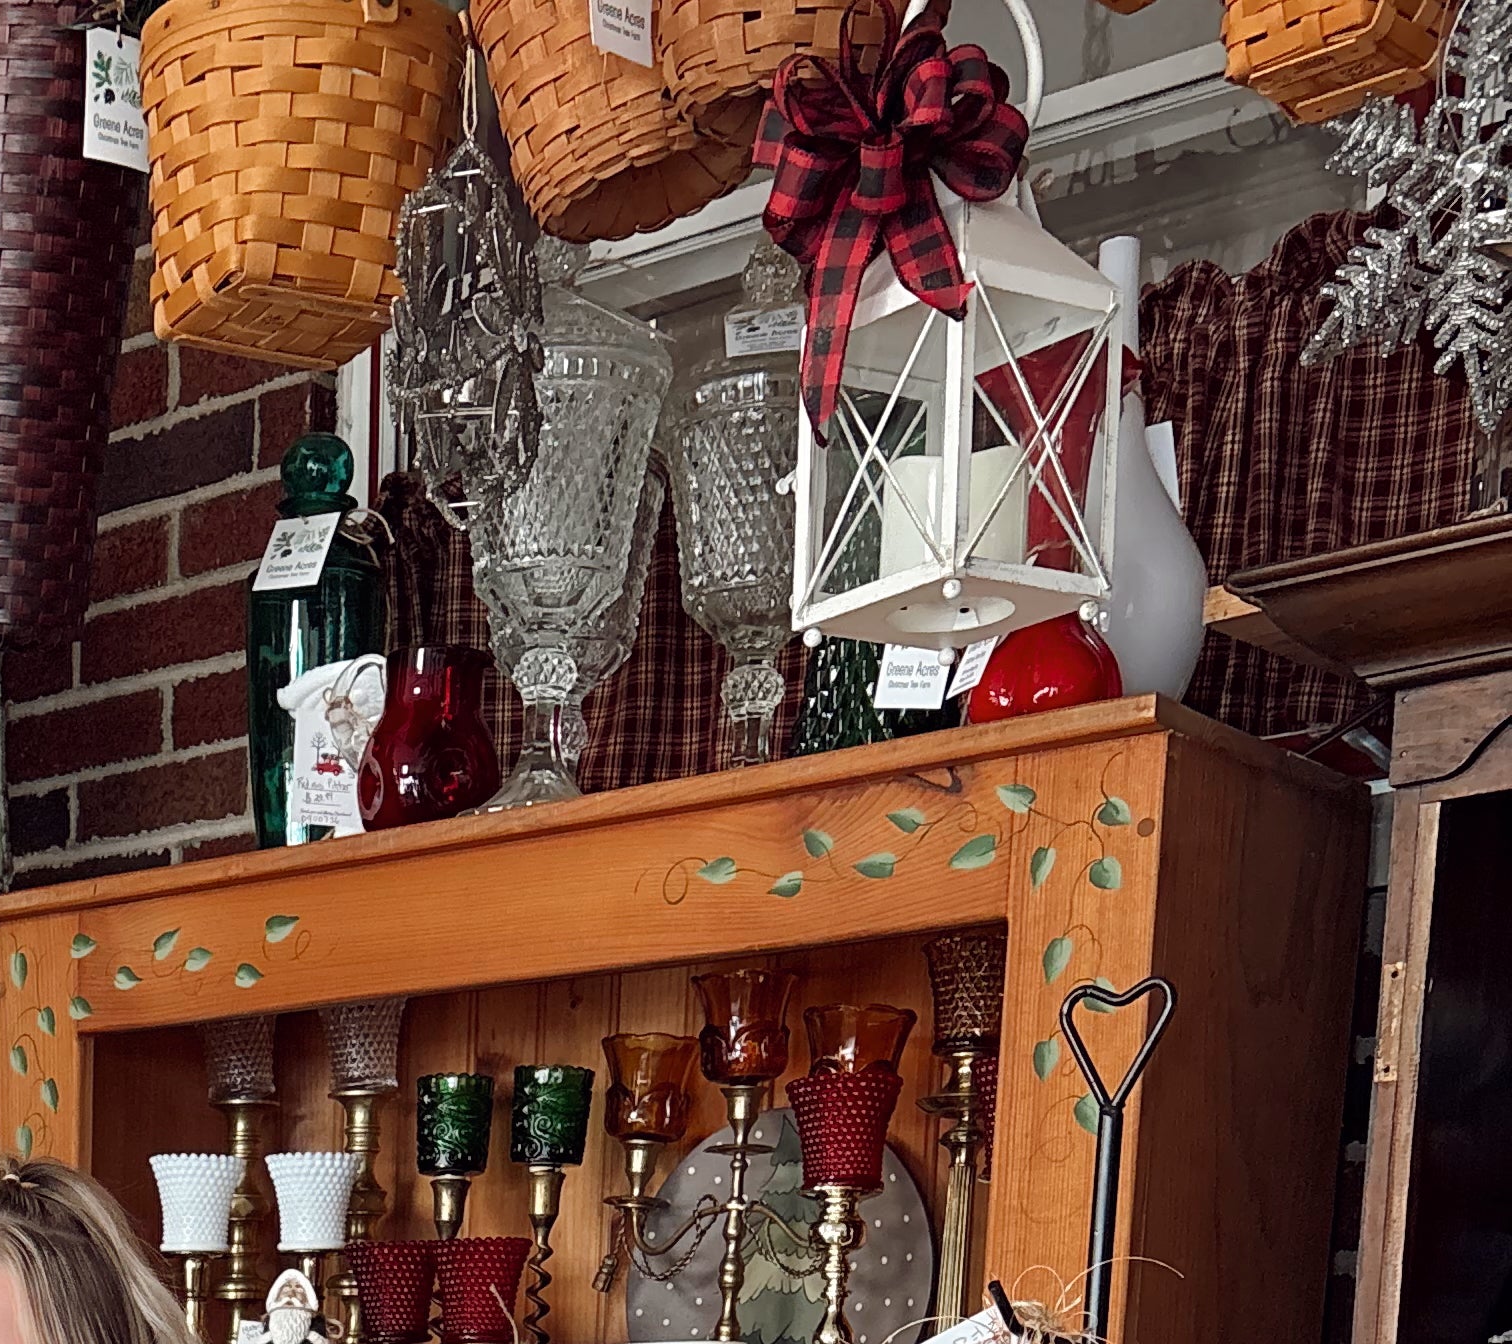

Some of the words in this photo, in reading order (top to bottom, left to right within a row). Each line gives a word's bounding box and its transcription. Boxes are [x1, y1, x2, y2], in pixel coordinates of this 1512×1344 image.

[93, 113, 120, 133] Greene
[123, 120, 143, 140] Acres
[886, 661, 914, 677] Greene
[916, 661, 941, 677] Acres
